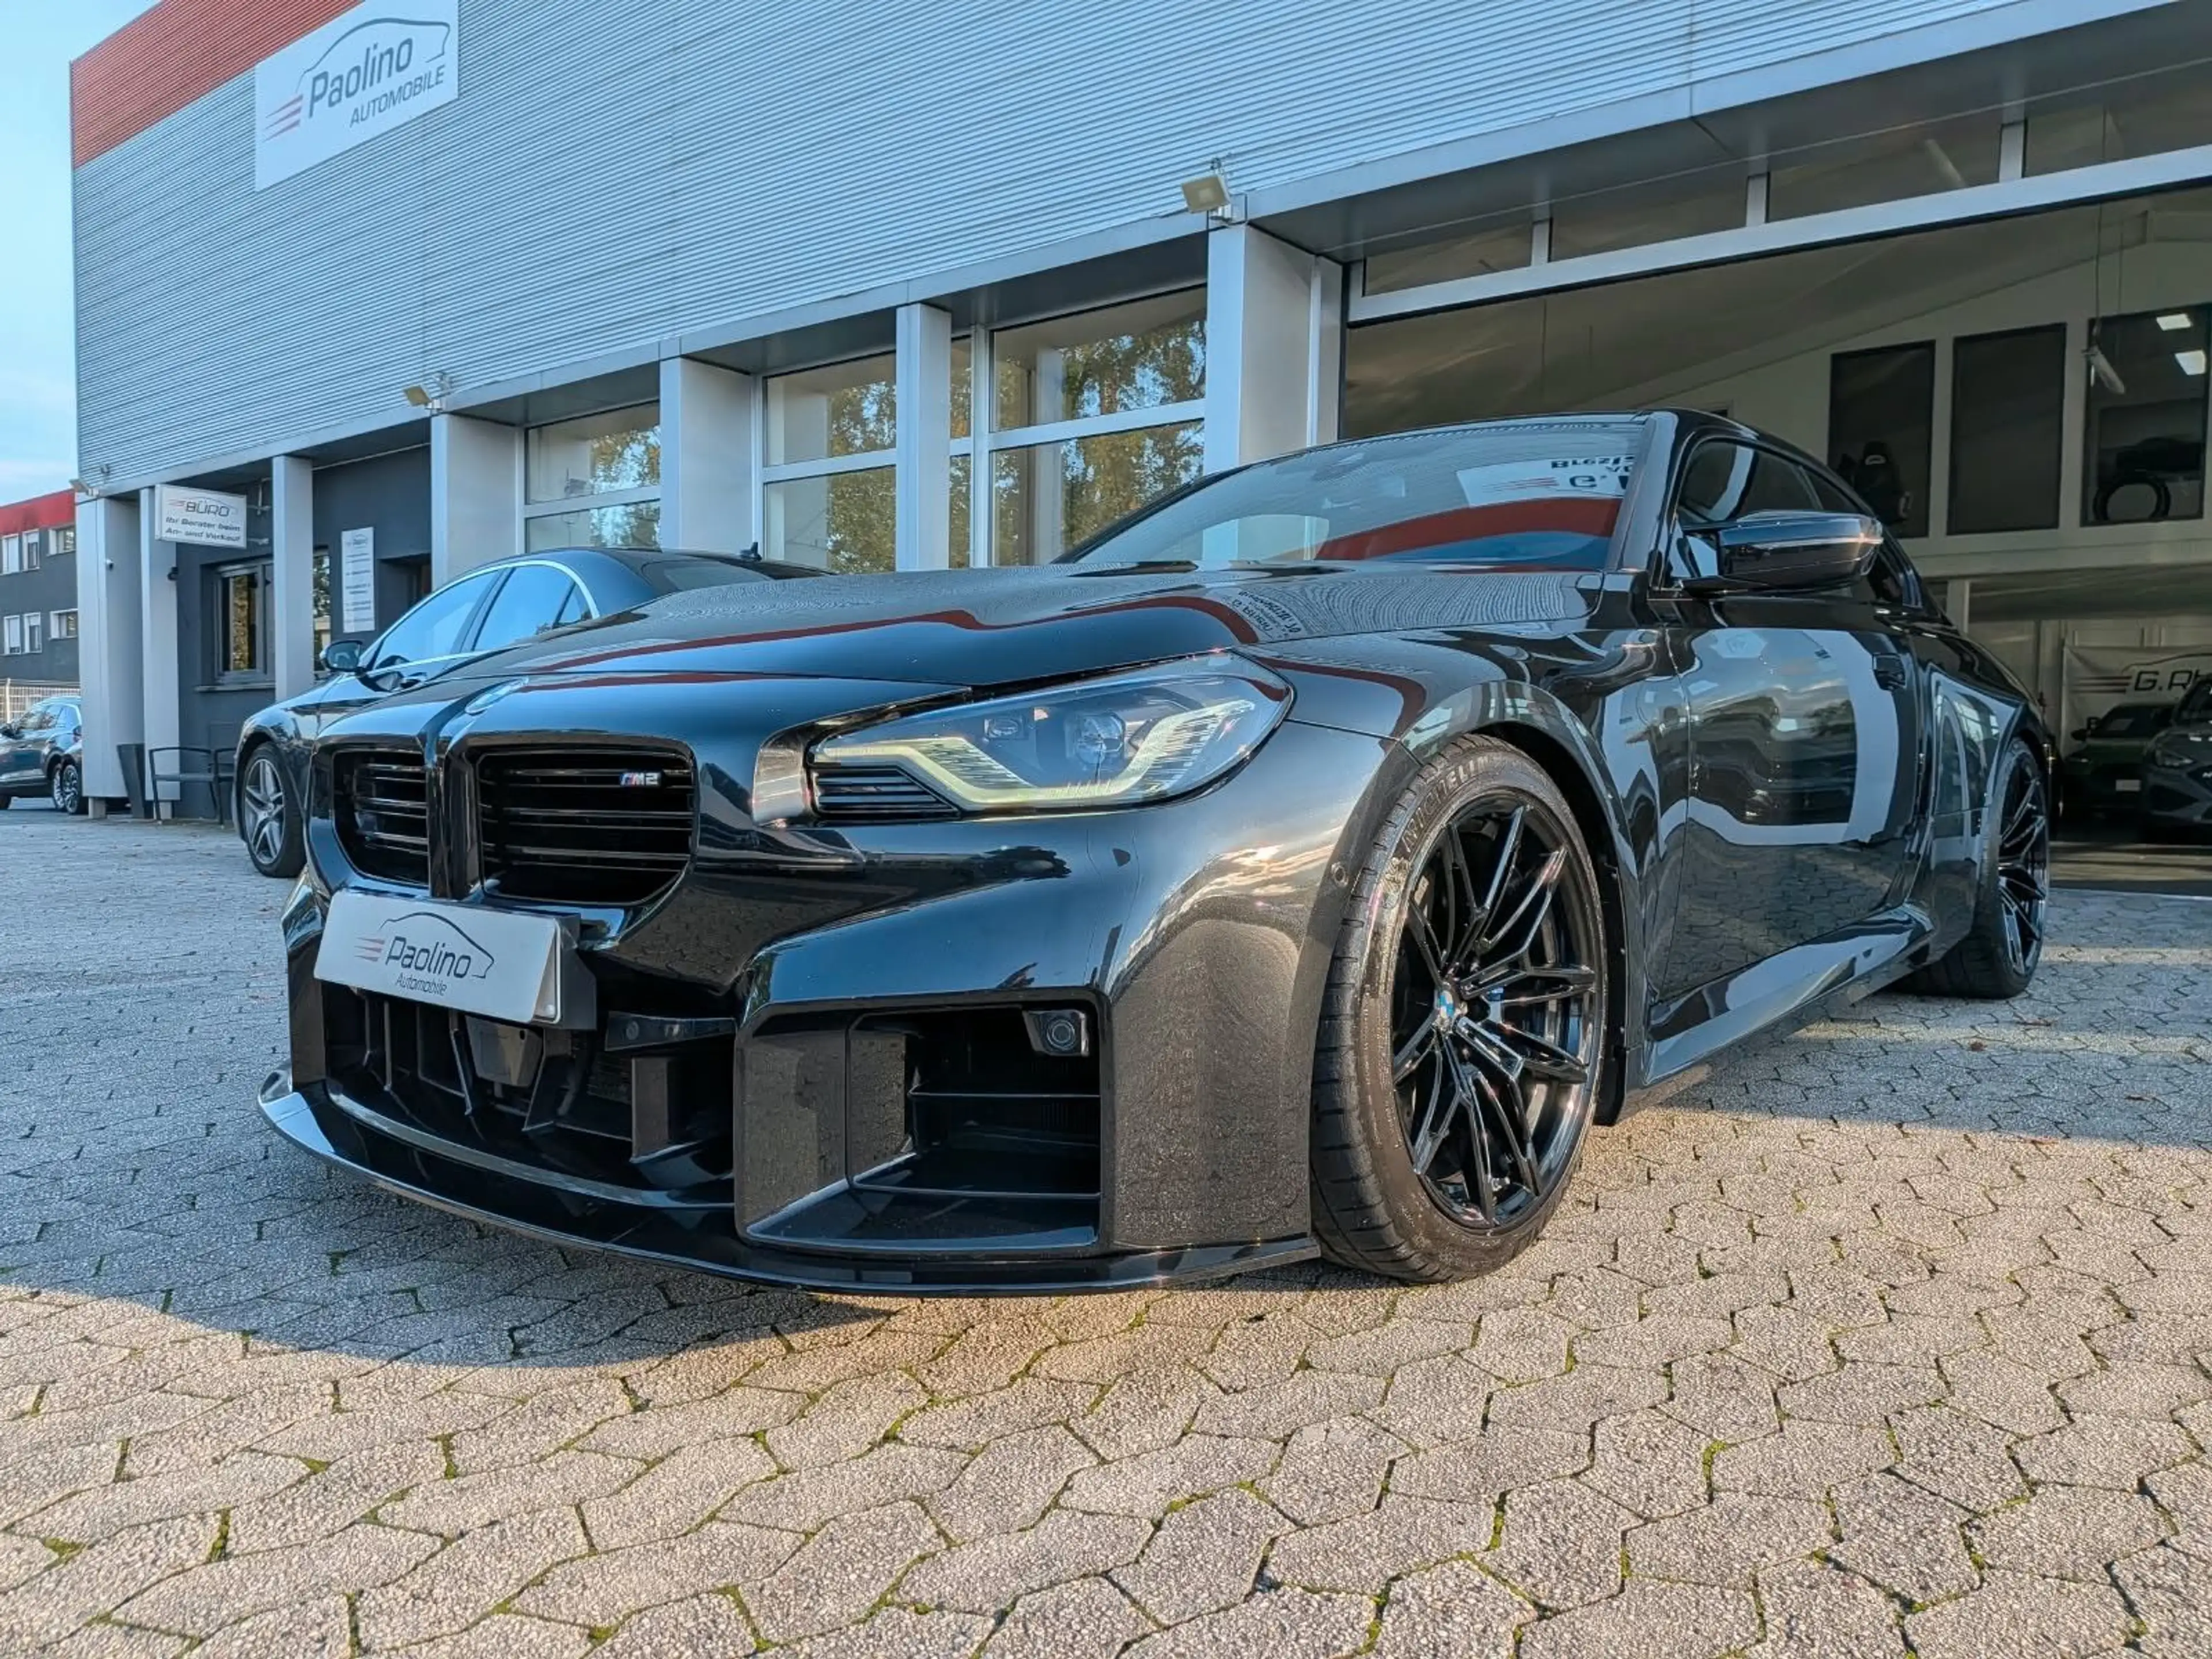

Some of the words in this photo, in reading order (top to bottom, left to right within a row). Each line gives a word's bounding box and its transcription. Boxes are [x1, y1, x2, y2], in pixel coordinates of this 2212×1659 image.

[308, 37, 413, 118] Paolino
[349, 64, 445, 128] AUTOMOBILE
[186, 499, 230, 517] BÜRO
[620, 772, 661, 786] M2
[385, 935, 472, 979] Paolino
[395, 972, 448, 997] Automobile
